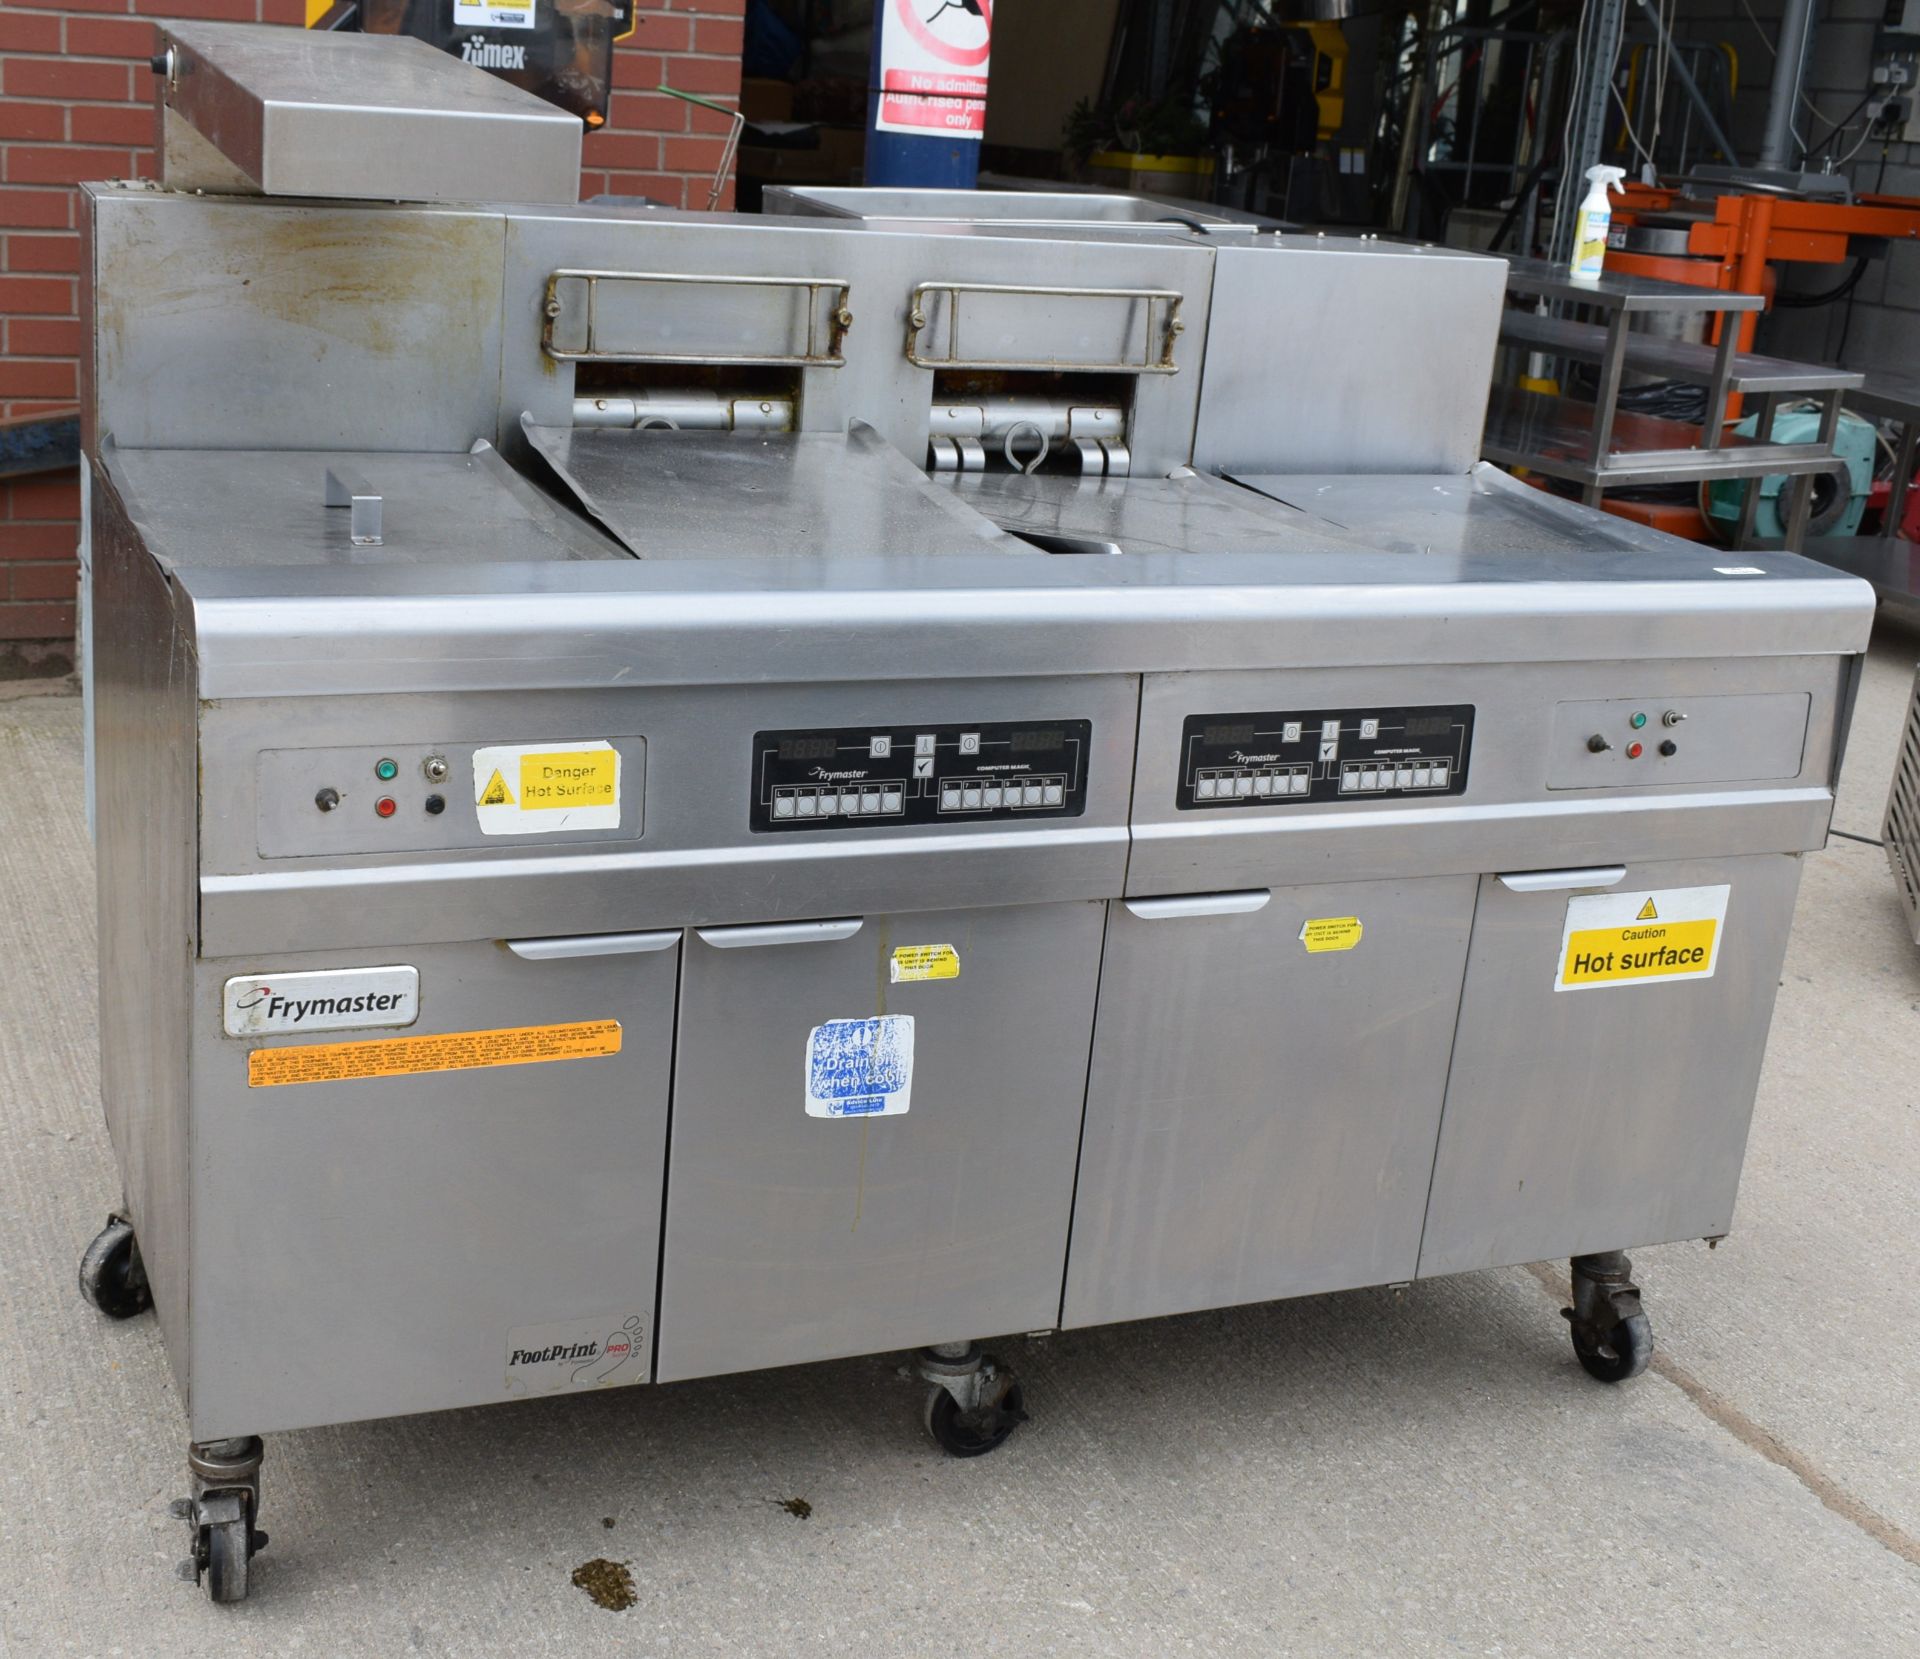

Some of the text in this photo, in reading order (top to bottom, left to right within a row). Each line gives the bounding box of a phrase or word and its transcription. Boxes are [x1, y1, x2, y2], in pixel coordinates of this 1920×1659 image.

[911, 76, 932, 90] No
[946, 113, 972, 129] only
[1237, 753, 1279, 764] Frymaster
[543, 766, 596, 781] Danger
[818, 769, 866, 781] Frymaster
[526, 785, 551, 797] Hot
[1622, 928, 1666, 941] Caution
[1574, 946, 1704, 974] Hot surface
[268, 992, 403, 1022] Frymaster
[827, 1055, 893, 1070] Drain oil
[817, 1071, 900, 1089] when cool
[509, 1341, 598, 1365] FootPrint
[607, 1344, 628, 1353] PRO
